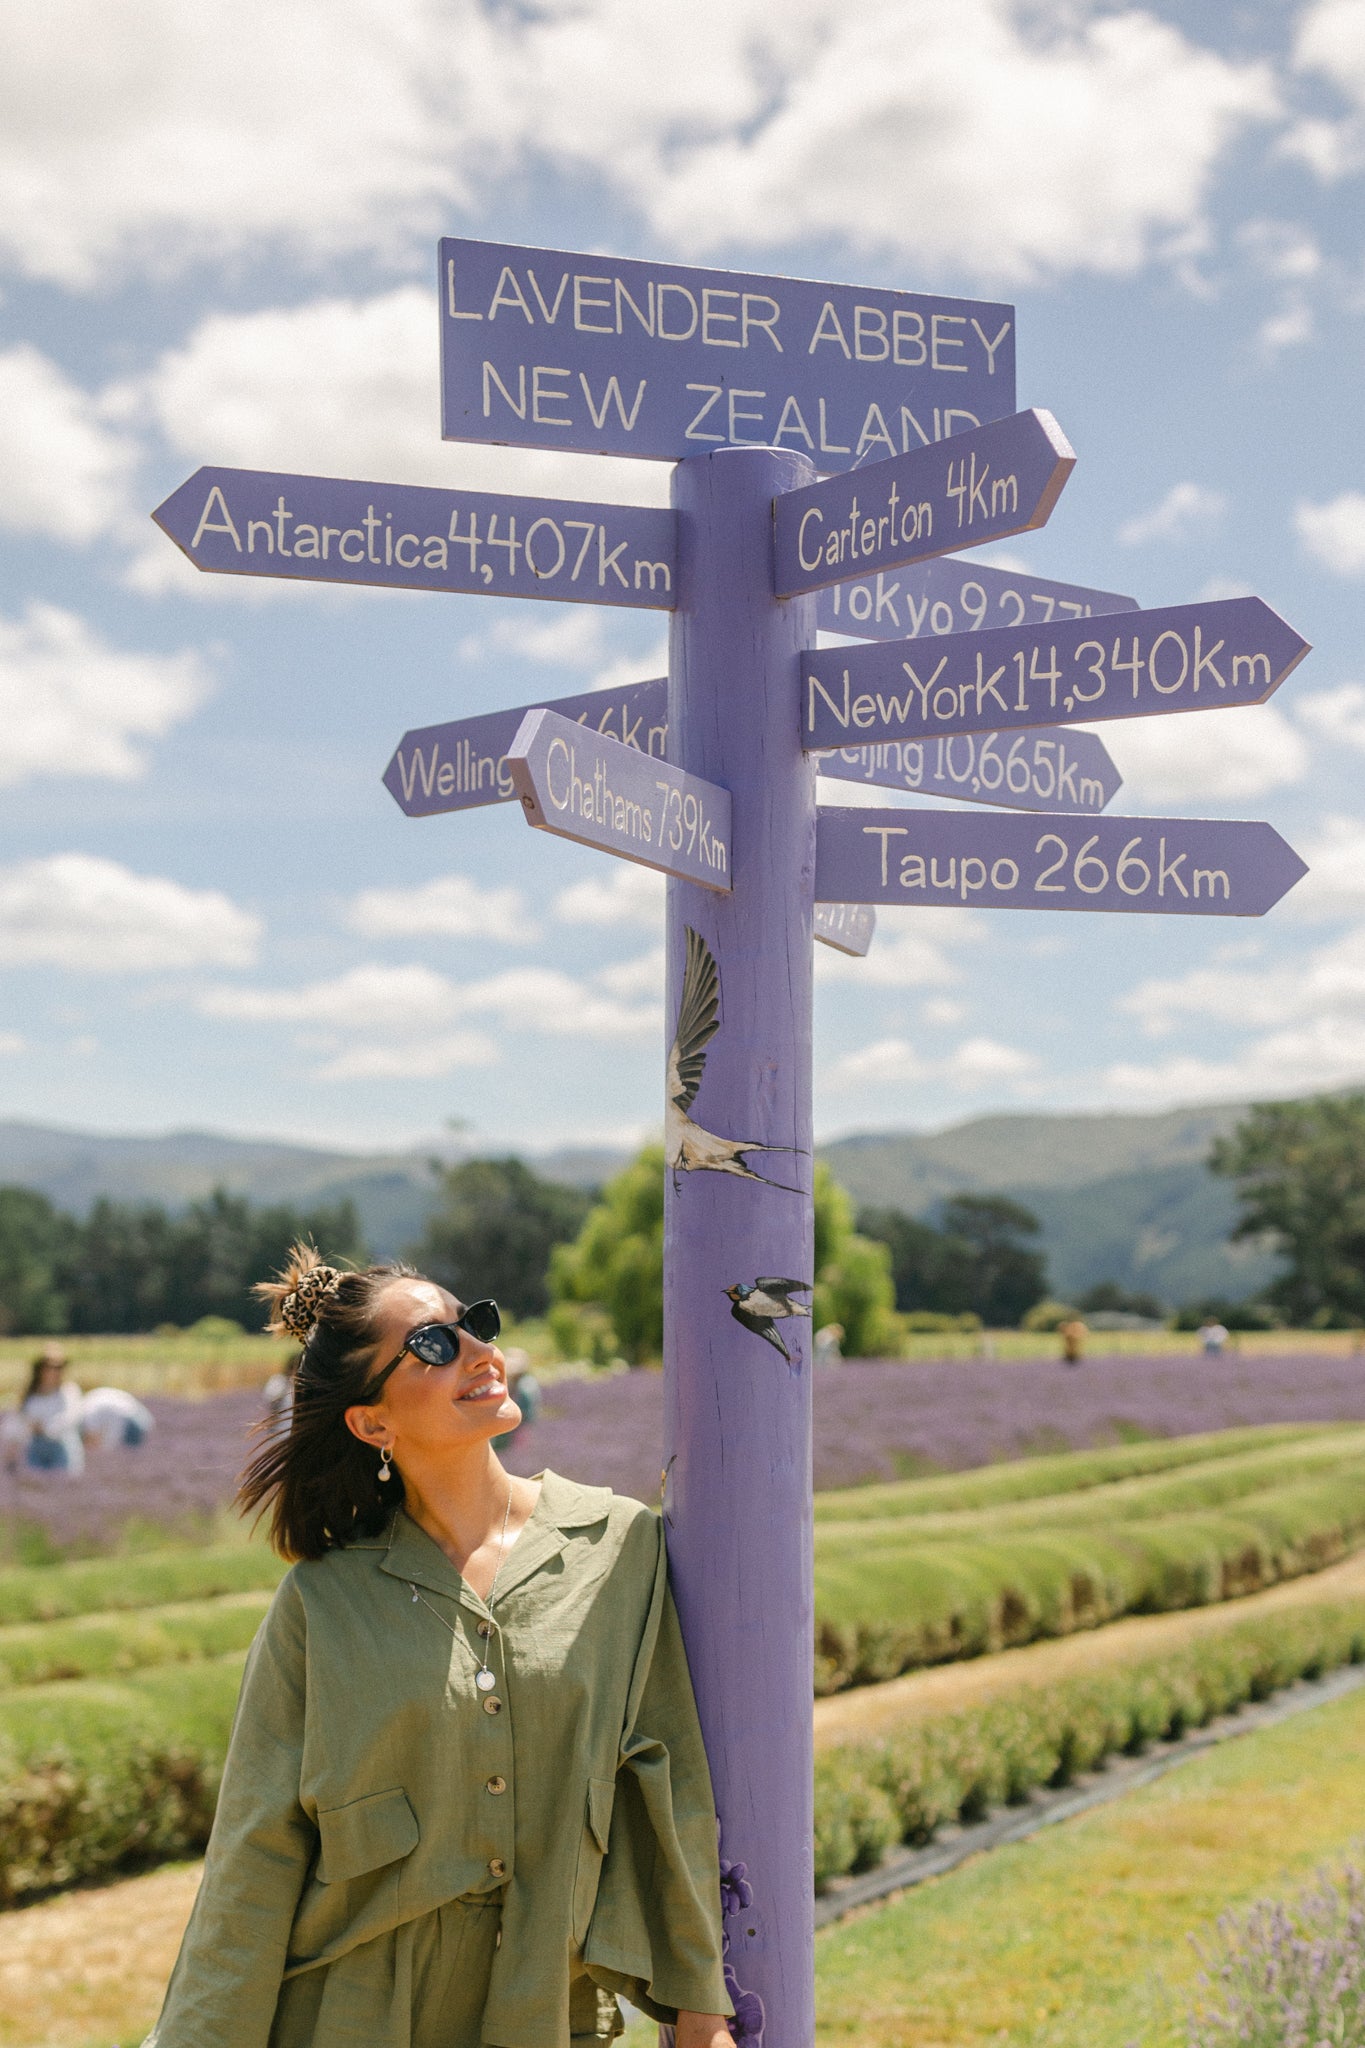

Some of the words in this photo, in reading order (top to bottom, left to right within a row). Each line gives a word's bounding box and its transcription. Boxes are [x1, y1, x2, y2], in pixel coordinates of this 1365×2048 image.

[448, 259, 784, 352] LAVENDER
[809, 302, 1011, 375] ABBEY
[482, 361, 647, 431] NEW
[799, 481, 932, 571] Carterton
[547, 738, 653, 843] Chathams
[863, 826, 1019, 899] Taupo
